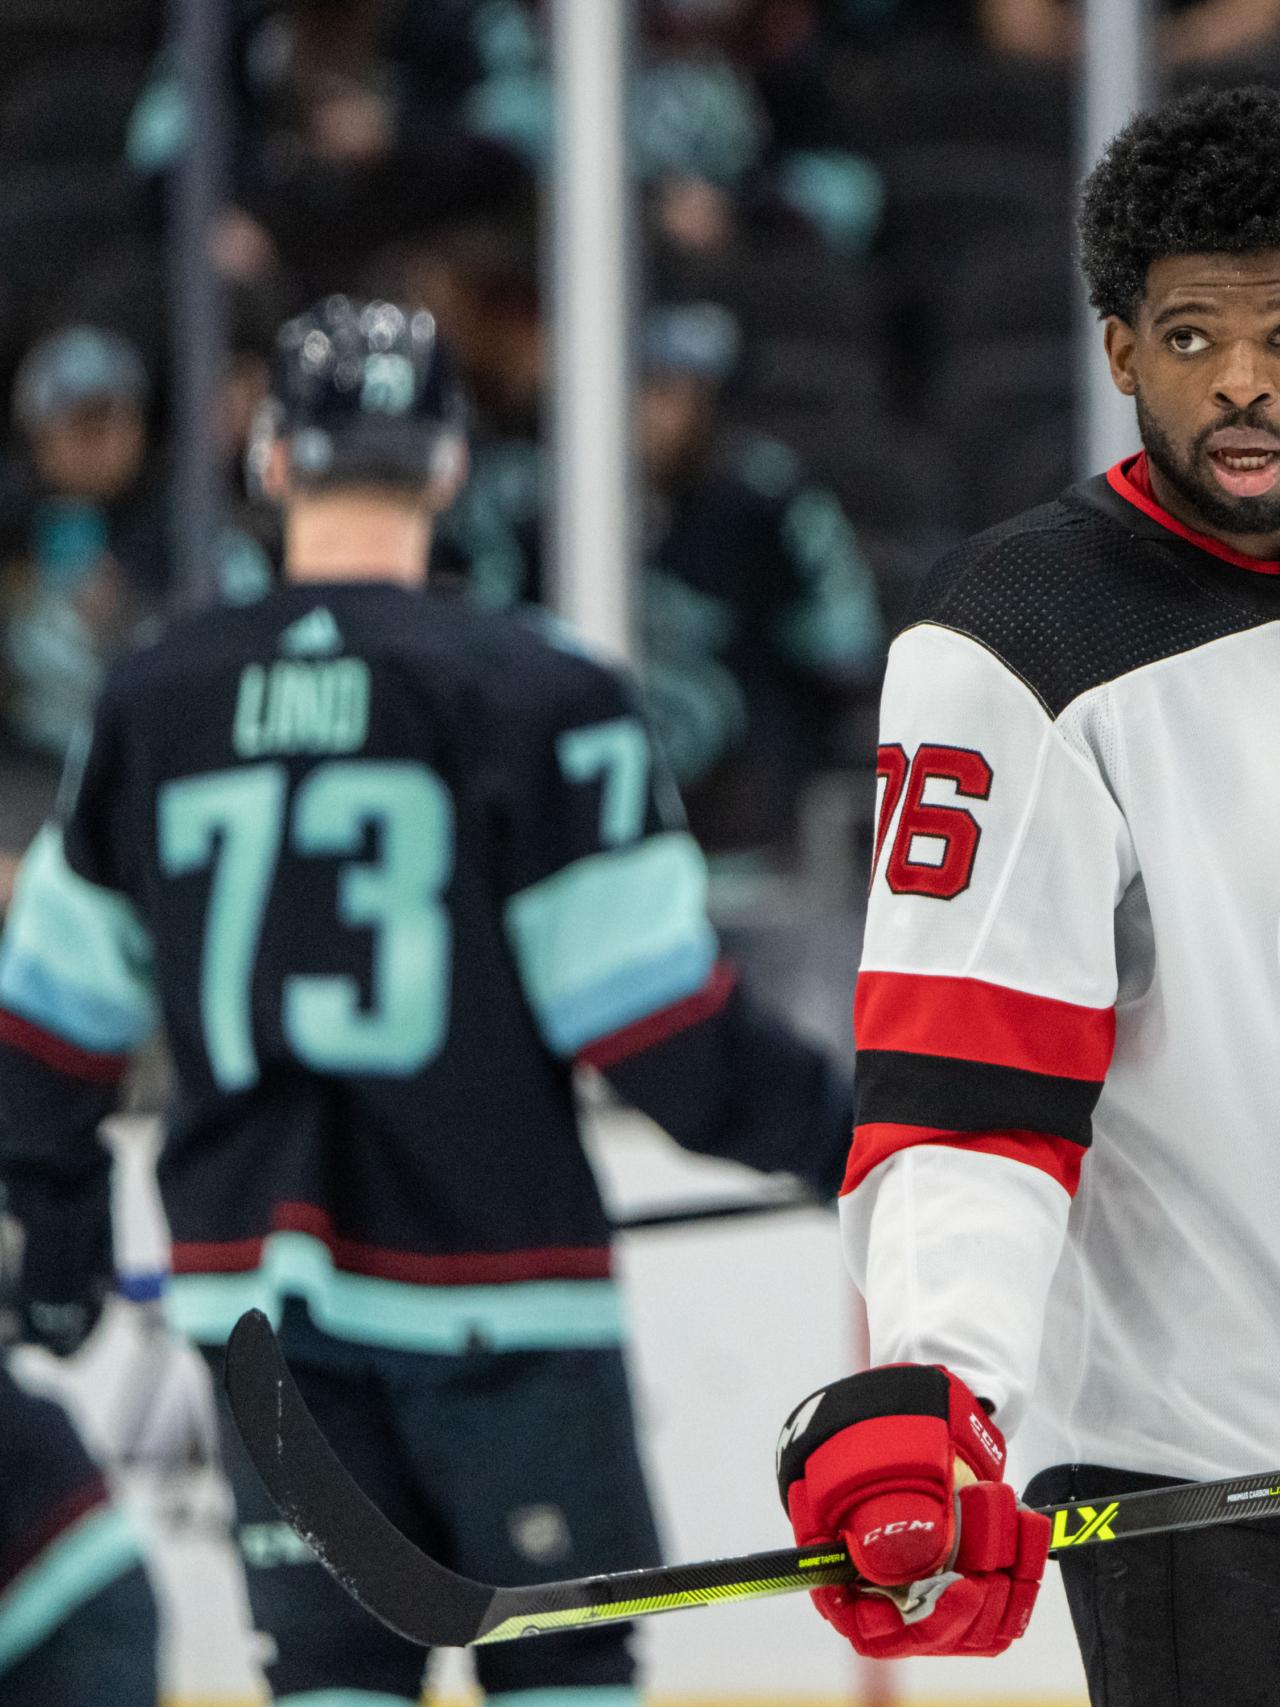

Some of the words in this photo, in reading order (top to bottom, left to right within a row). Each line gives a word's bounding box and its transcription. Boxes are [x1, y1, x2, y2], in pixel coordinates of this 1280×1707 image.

[236, 659, 371, 756] LIND
[158, 760, 453, 1093] 73
[969, 1411, 1003, 1461] CCM
[863, 1520, 935, 1547] CCM
[1051, 1502, 1120, 1550] LX
